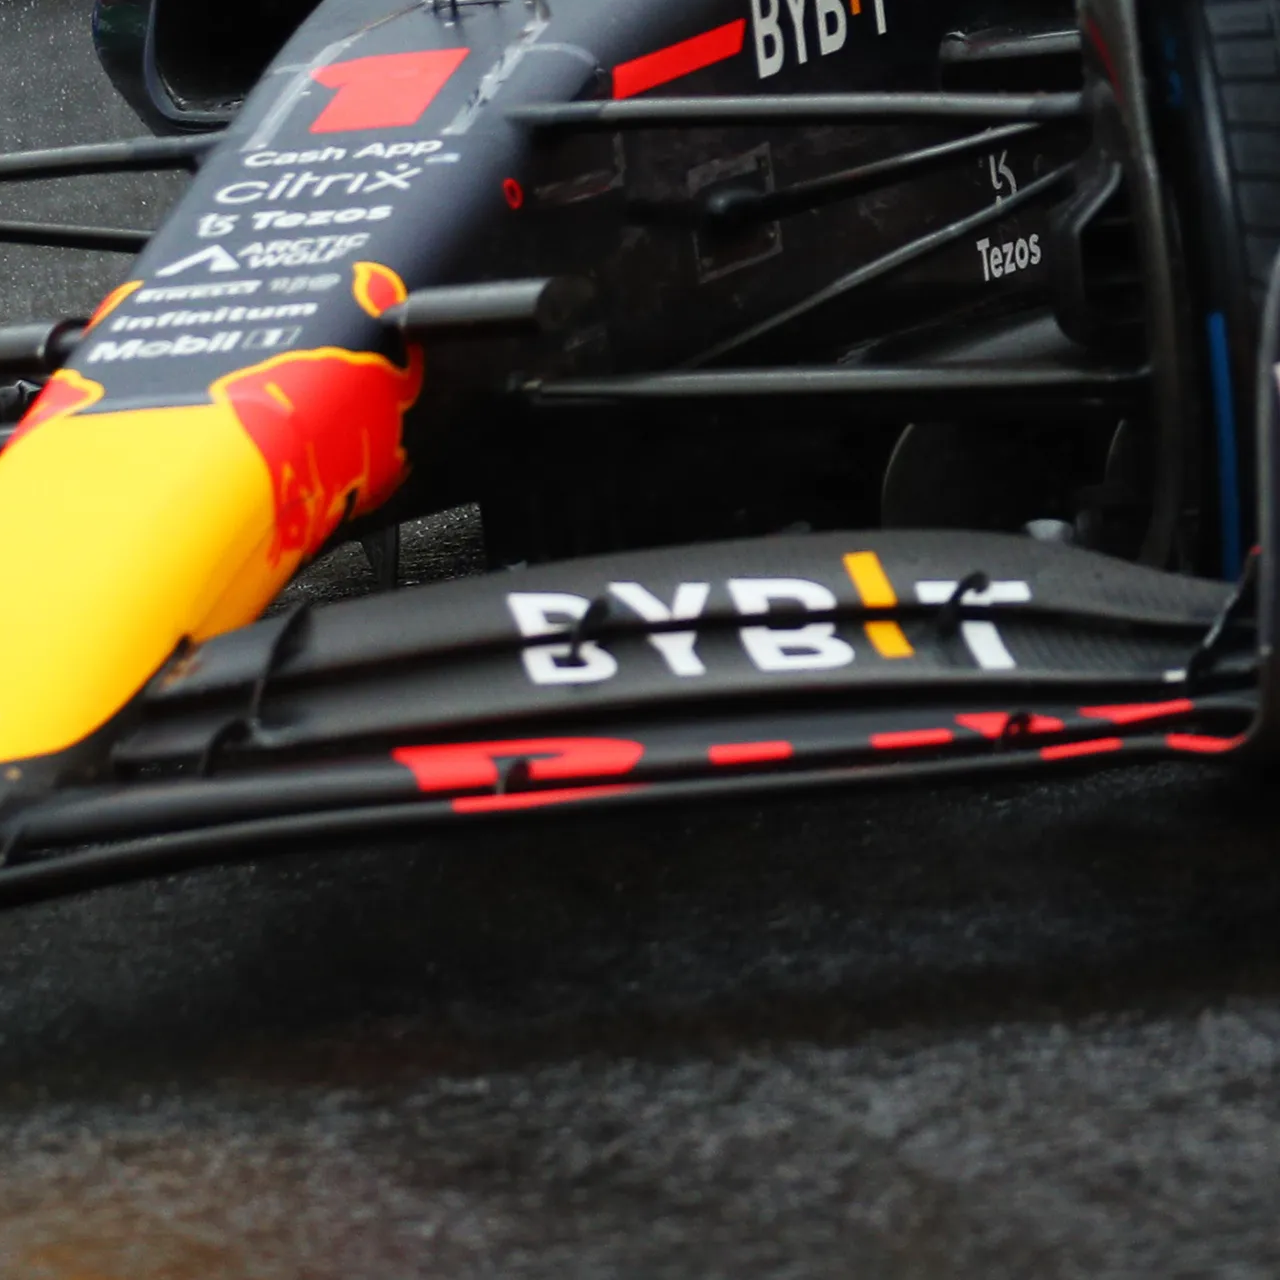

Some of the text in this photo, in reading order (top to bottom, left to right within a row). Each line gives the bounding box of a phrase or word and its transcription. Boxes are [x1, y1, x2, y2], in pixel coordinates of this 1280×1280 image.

[310, 48, 469, 133] 1
[244, 139, 443, 168] Cash App
[976, 233, 1041, 281] Tezos
